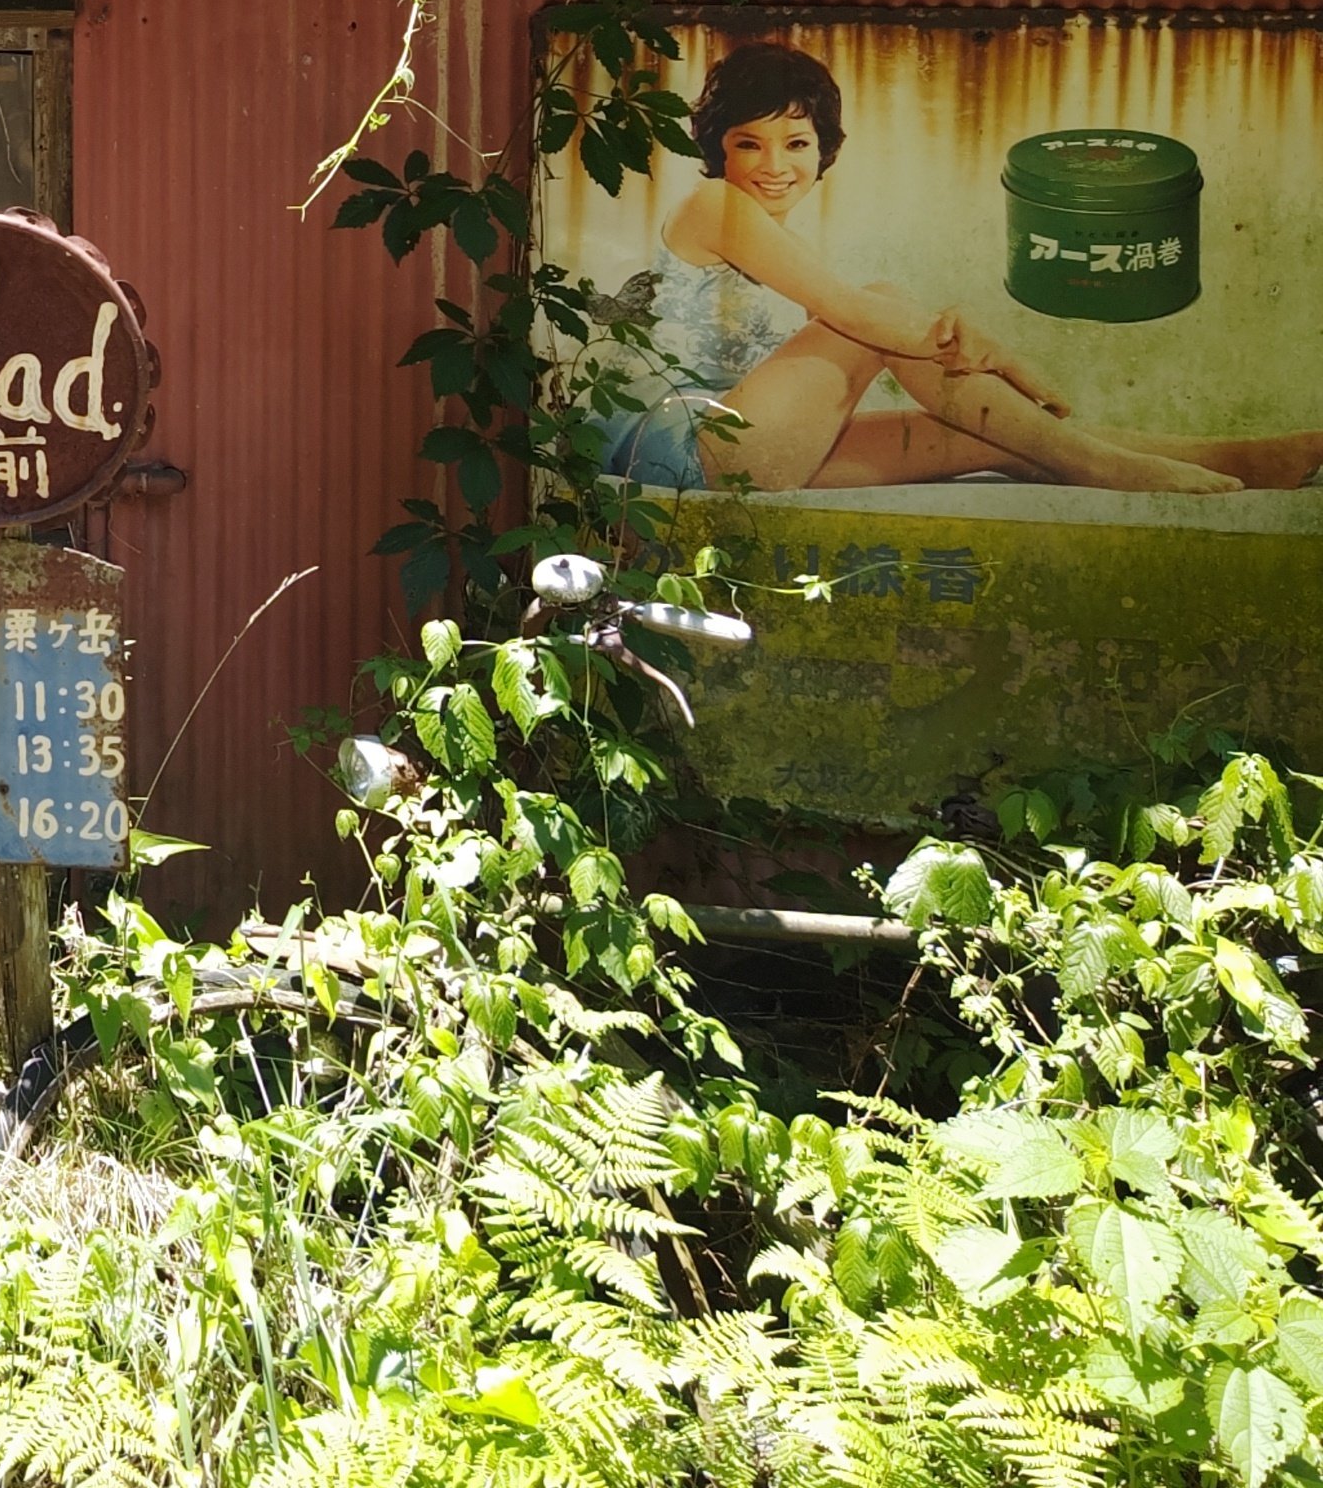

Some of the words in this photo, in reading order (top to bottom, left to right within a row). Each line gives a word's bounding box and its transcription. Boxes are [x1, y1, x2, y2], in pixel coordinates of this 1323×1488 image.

[1029, 232, 1184, 273] アース渦巻
[635, 542, 983, 605] かり線香
[14, 680, 126, 722] 11:30
[17, 734, 126, 778] 13:35
[19, 797, 130, 842] 16:20
